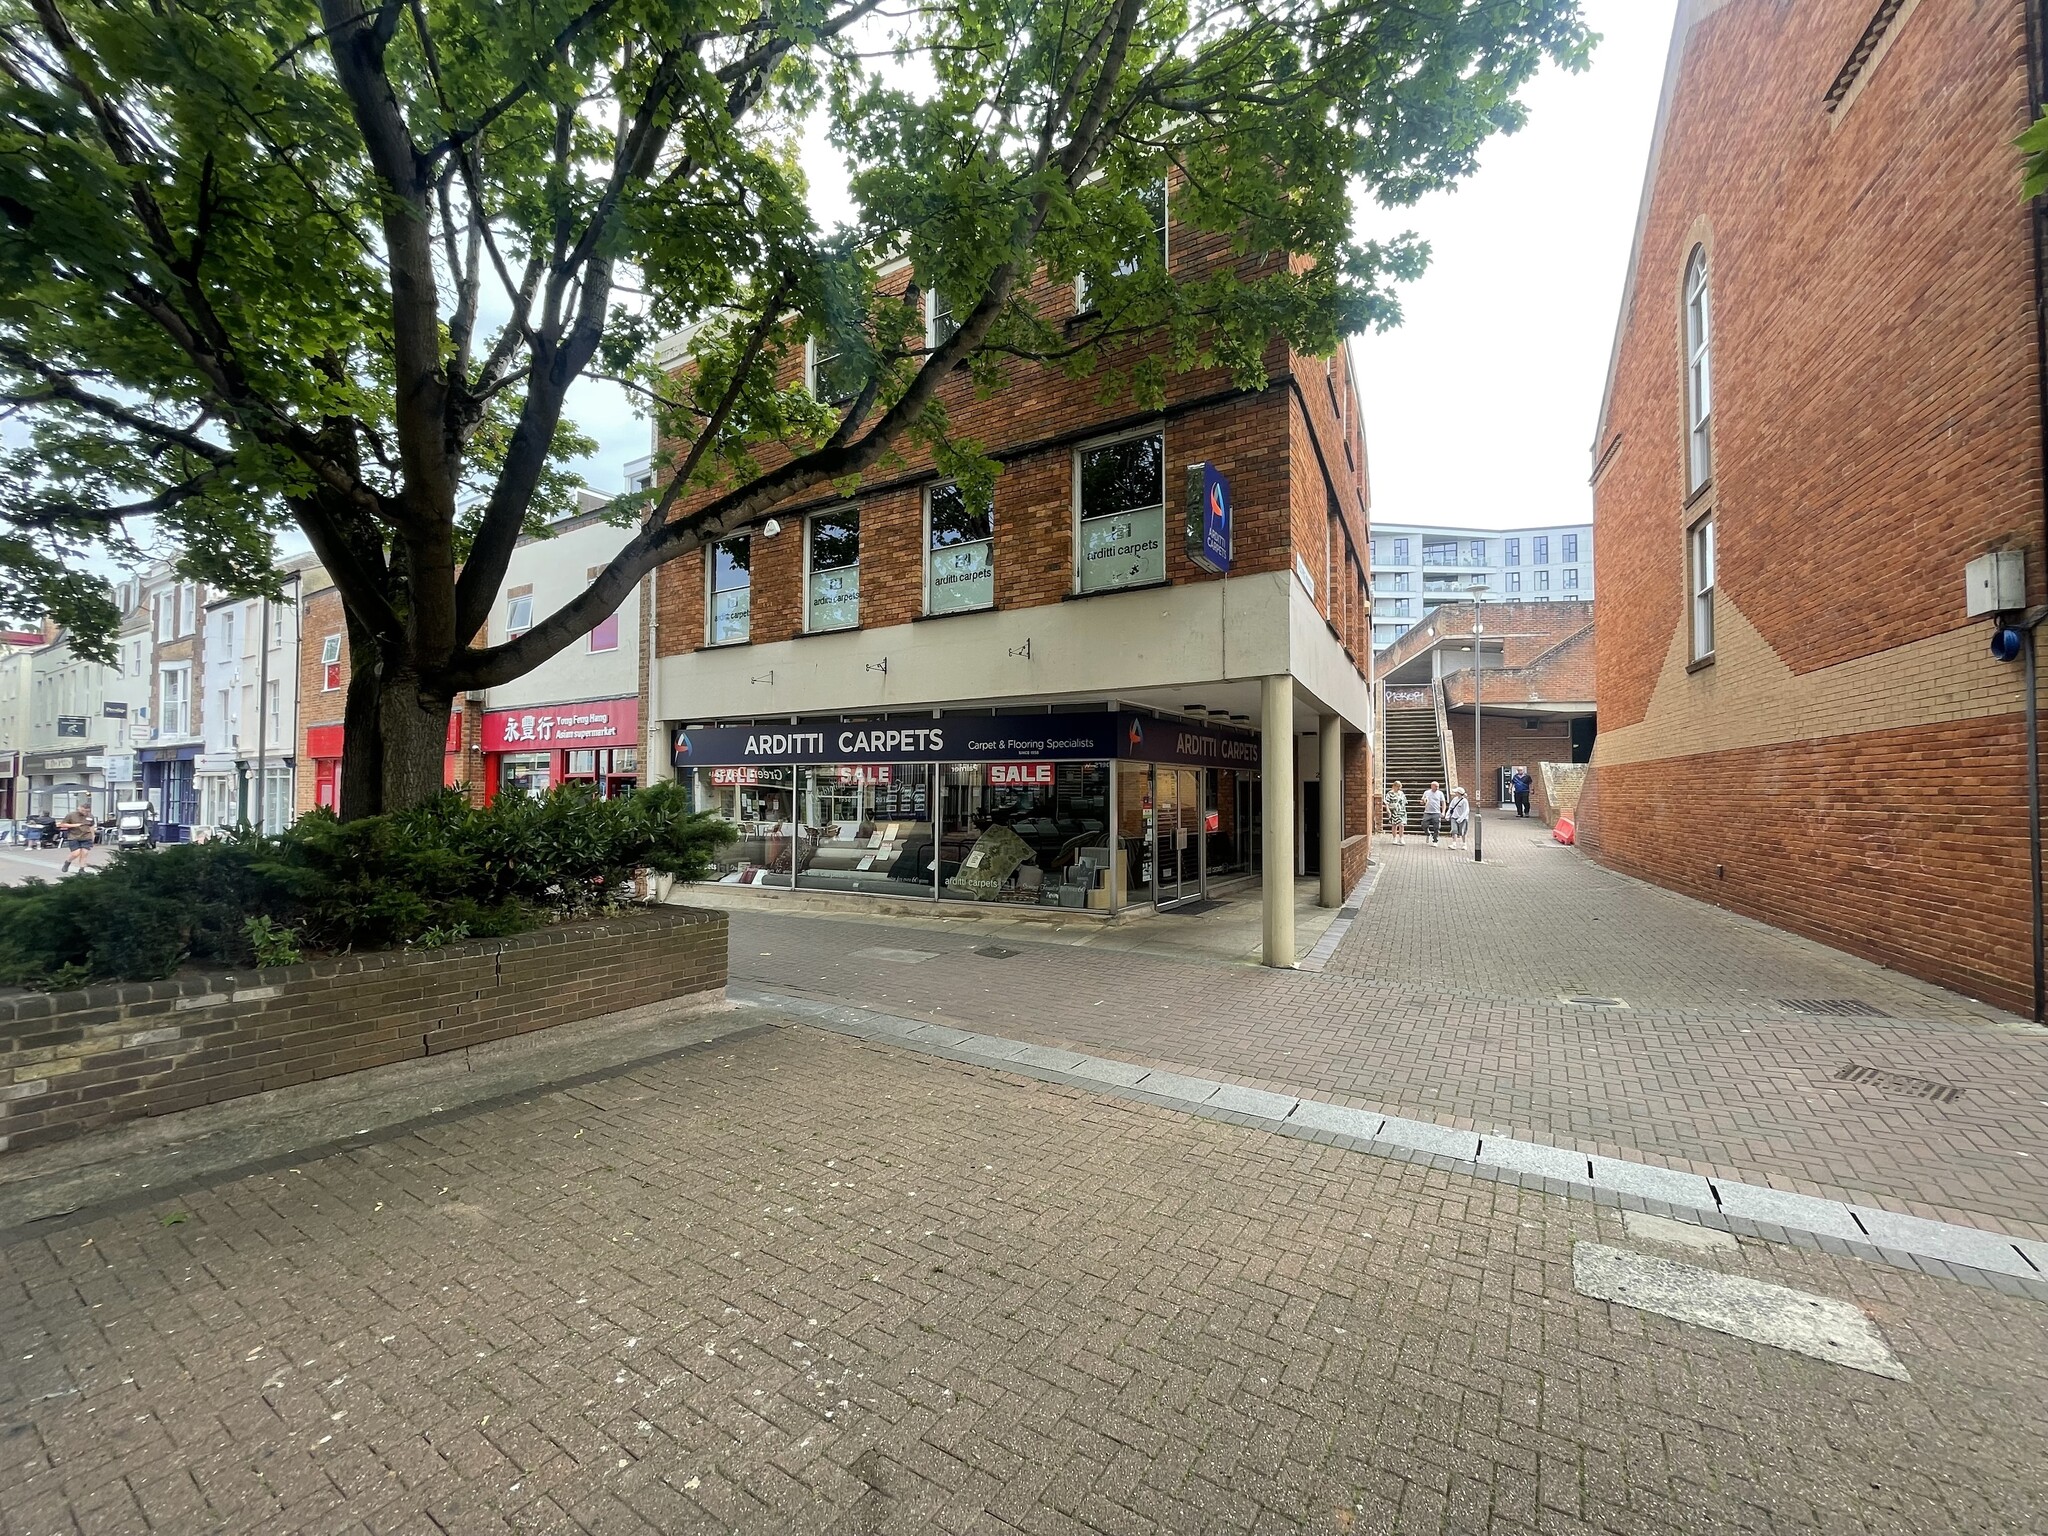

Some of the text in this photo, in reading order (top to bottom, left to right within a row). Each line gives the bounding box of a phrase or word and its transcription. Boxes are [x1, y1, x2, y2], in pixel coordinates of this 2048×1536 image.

[1208, 527, 1226, 549] ARDITTI
[1117, 540, 1159, 556] carpets
[1207, 536, 1227, 560] CARPETS
[935, 568, 992, 586] arditti carpets
[556, 713, 608, 727] Yong Feng Hang
[503, 715, 555, 743] 永豐行
[556, 726, 617, 739] Asian supermarket
[744, 728, 944, 755] ARDITTI CARPETS
[967, 738, 1094, 751] Carpet & Flooring Specialists
[1176, 732, 1259, 761] ARDITTI CARPETS
[715, 767, 756, 783] SALE
[840, 766, 889, 783] SALE
[991, 765, 1051, 783] SALE
[944, 877, 998, 889] arditti carpets
